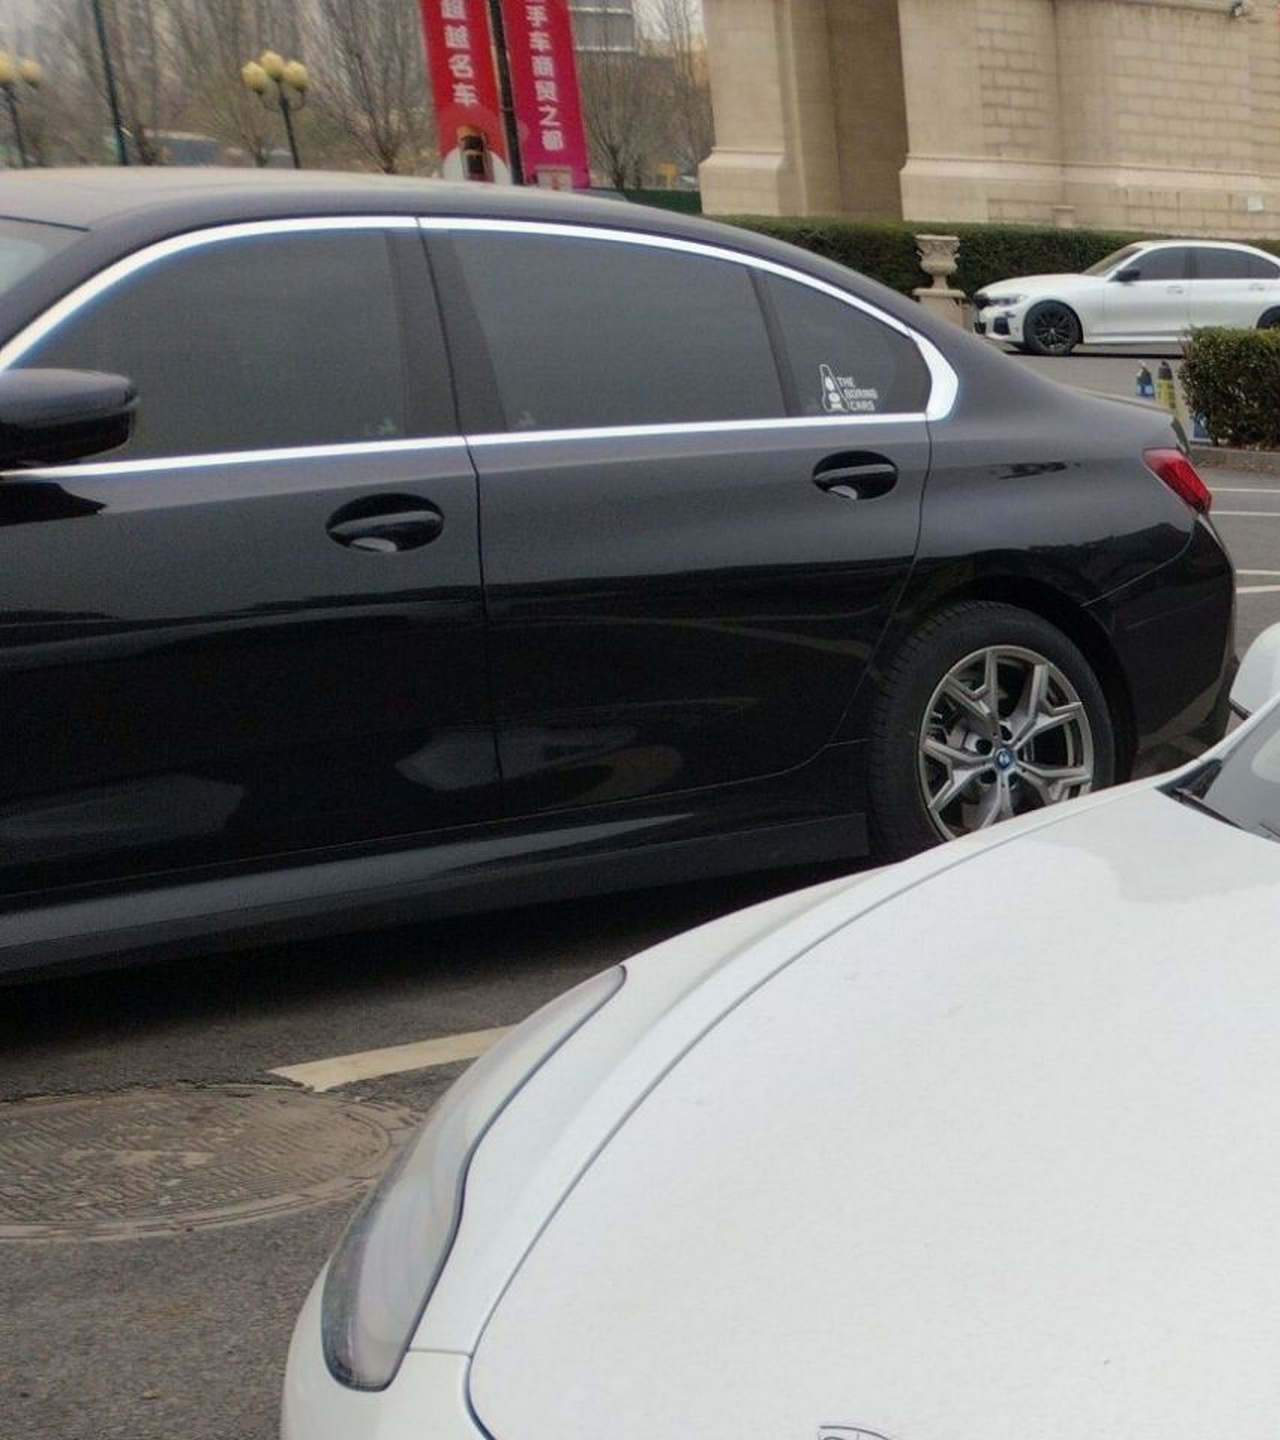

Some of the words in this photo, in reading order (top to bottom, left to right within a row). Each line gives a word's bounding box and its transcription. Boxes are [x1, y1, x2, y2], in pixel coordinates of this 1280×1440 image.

[524, 0, 564, 151] 手车商贸之都
[836, 377, 855, 387] THE
